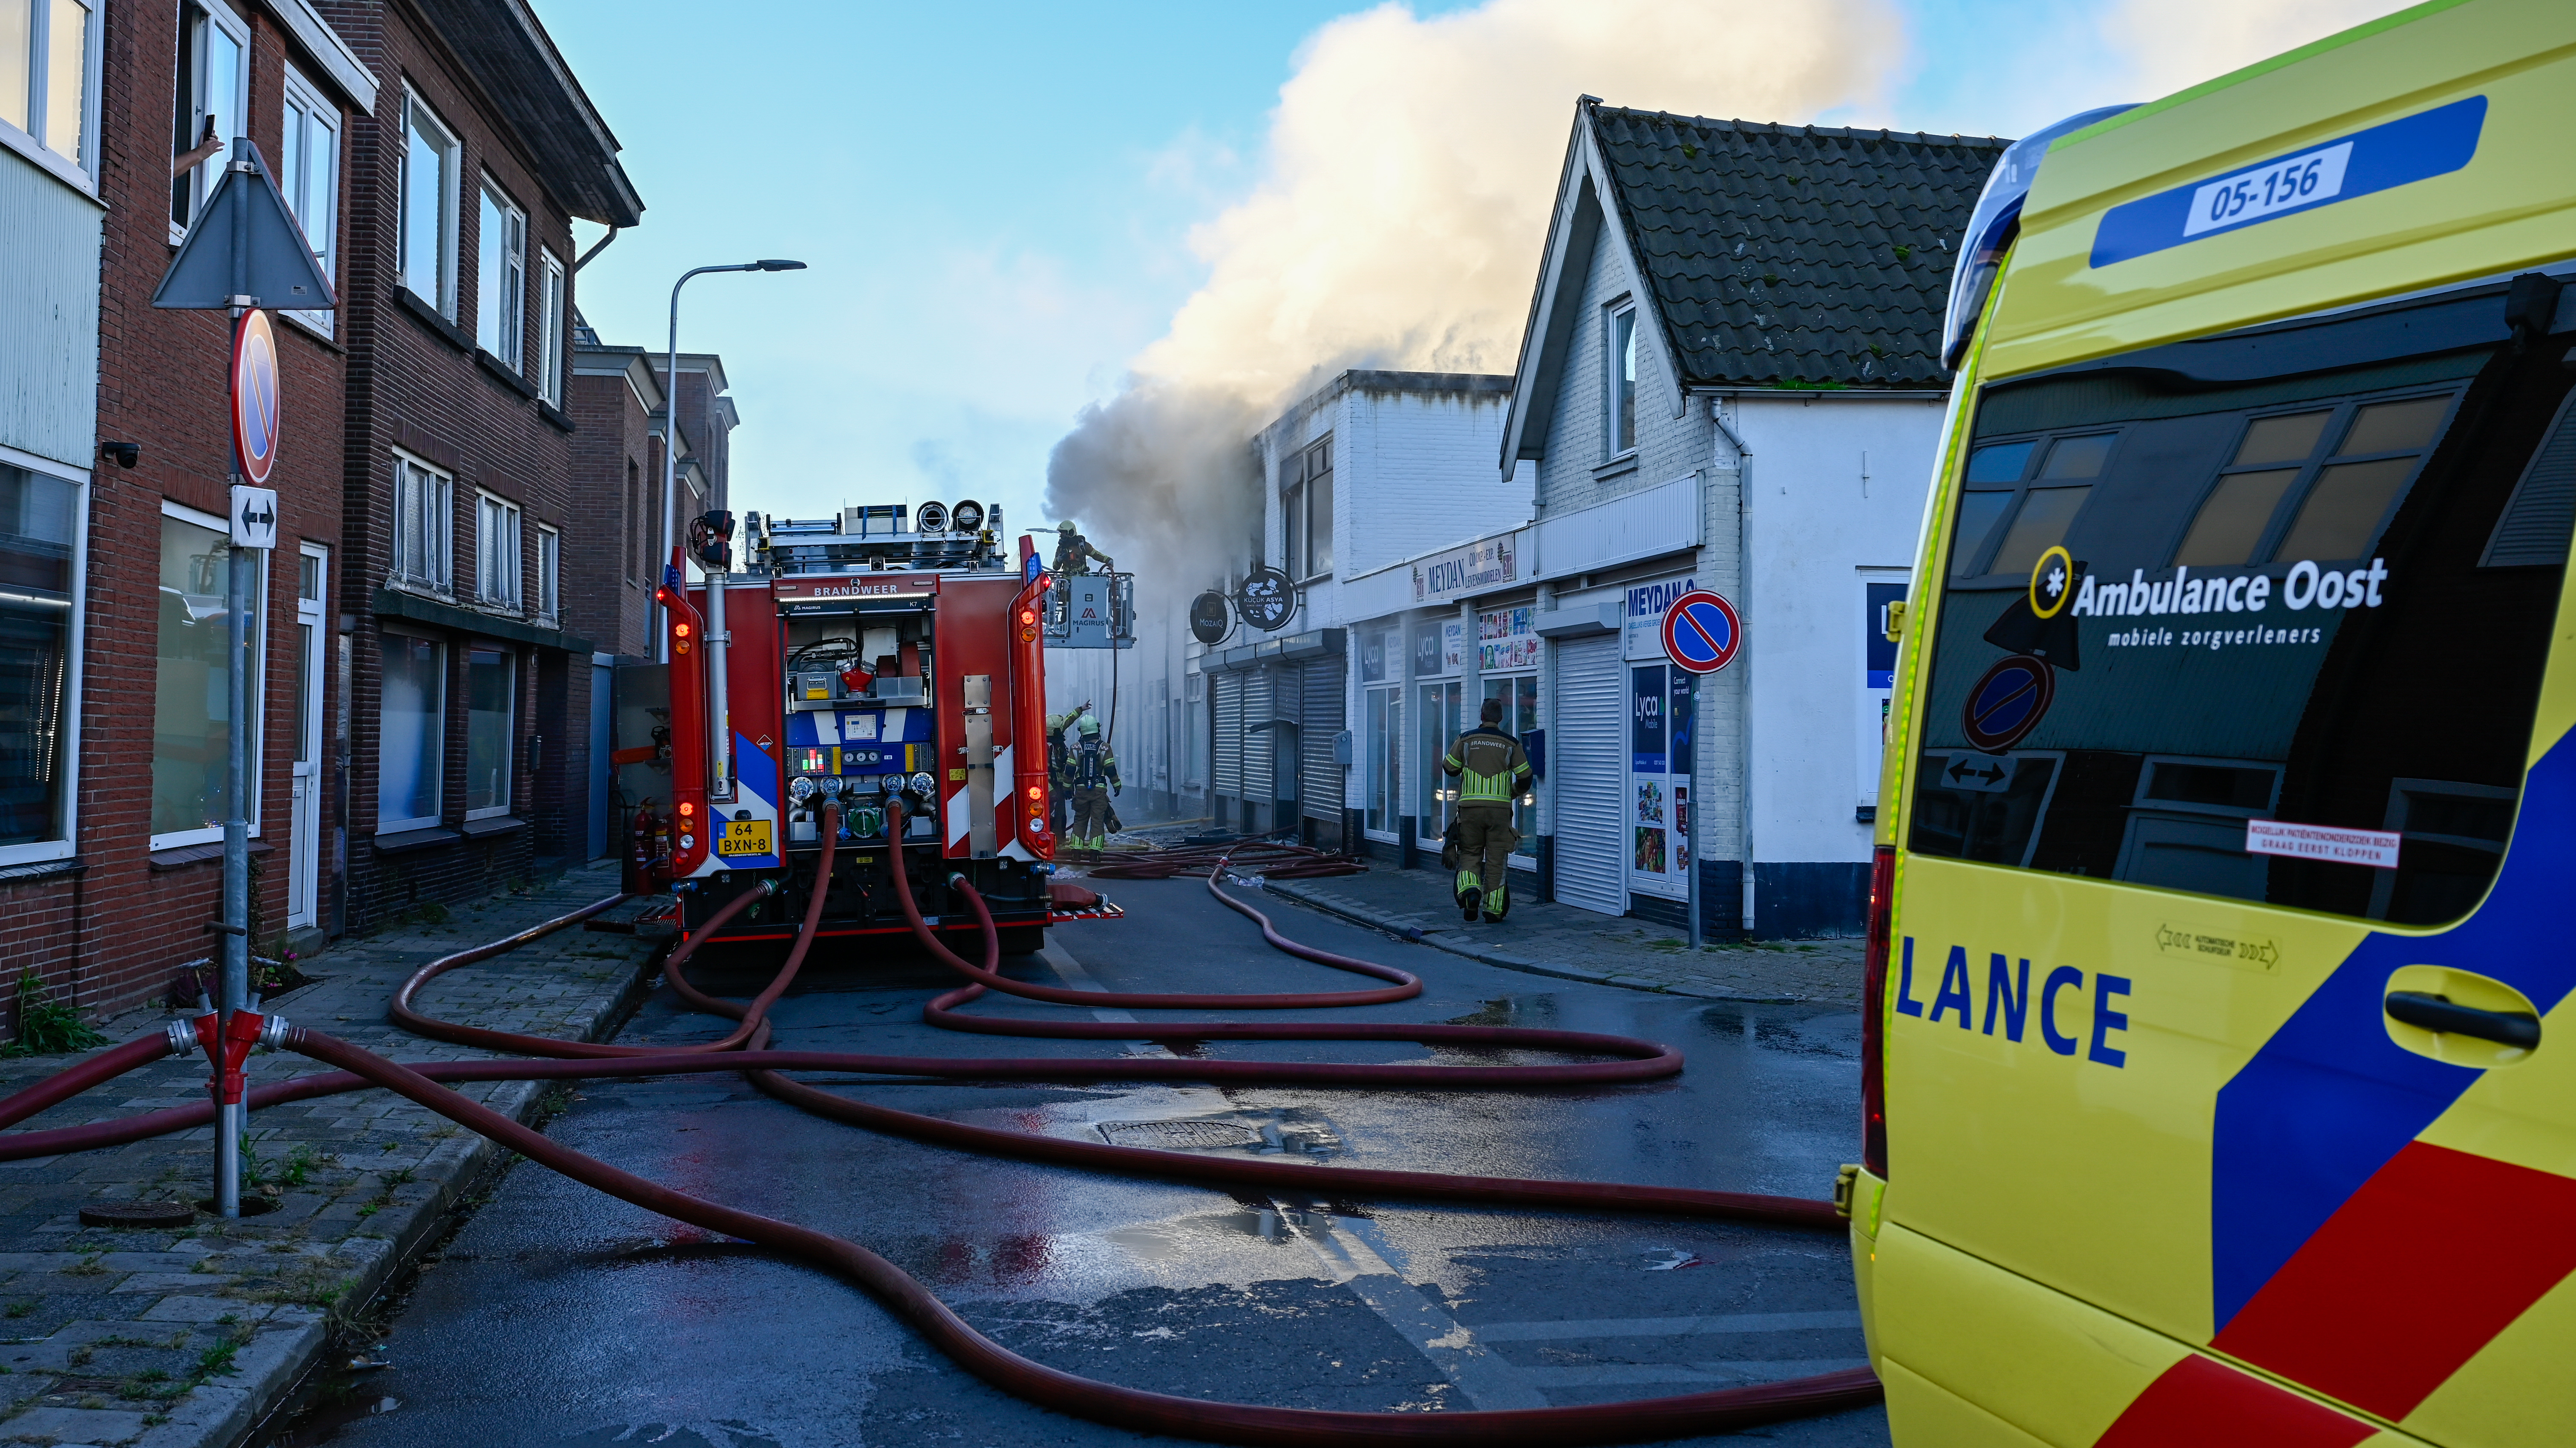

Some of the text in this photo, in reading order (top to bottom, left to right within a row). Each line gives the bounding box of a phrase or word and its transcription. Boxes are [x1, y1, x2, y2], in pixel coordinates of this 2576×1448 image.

[2210, 158, 2323, 222] 05-156
[1469, 552, 1475, 567] CO
[1428, 558, 1464, 594] MEYDAN
[1465, 568, 1501, 588] LEVENSMIDDELEN
[814, 584, 897, 596] BRANDWEER
[2070, 557, 2388, 617] Ambulance Oost
[1628, 581, 1681, 617] MEYDAN
[1446, 624, 1461, 637] MEYDAN
[2107, 624, 2321, 651] mobiele zorgverleners
[1365, 643, 1378, 669] Lyca
[1418, 634, 1434, 661] Lyca
[1674, 676, 1686, 685] Connect
[1681, 686, 1689, 695] world
[1635, 692, 1658, 721] Lyca
[1645, 718, 1658, 729] Mobile
[1471, 741, 1505, 749] BRANDWEER
[735, 824, 752, 836] 64
[724, 839, 766, 851] BXN-8
[2261, 839, 2382, 860] GRAAG EERST KLOPPEN
[1896, 936, 2132, 1069] LANCE
